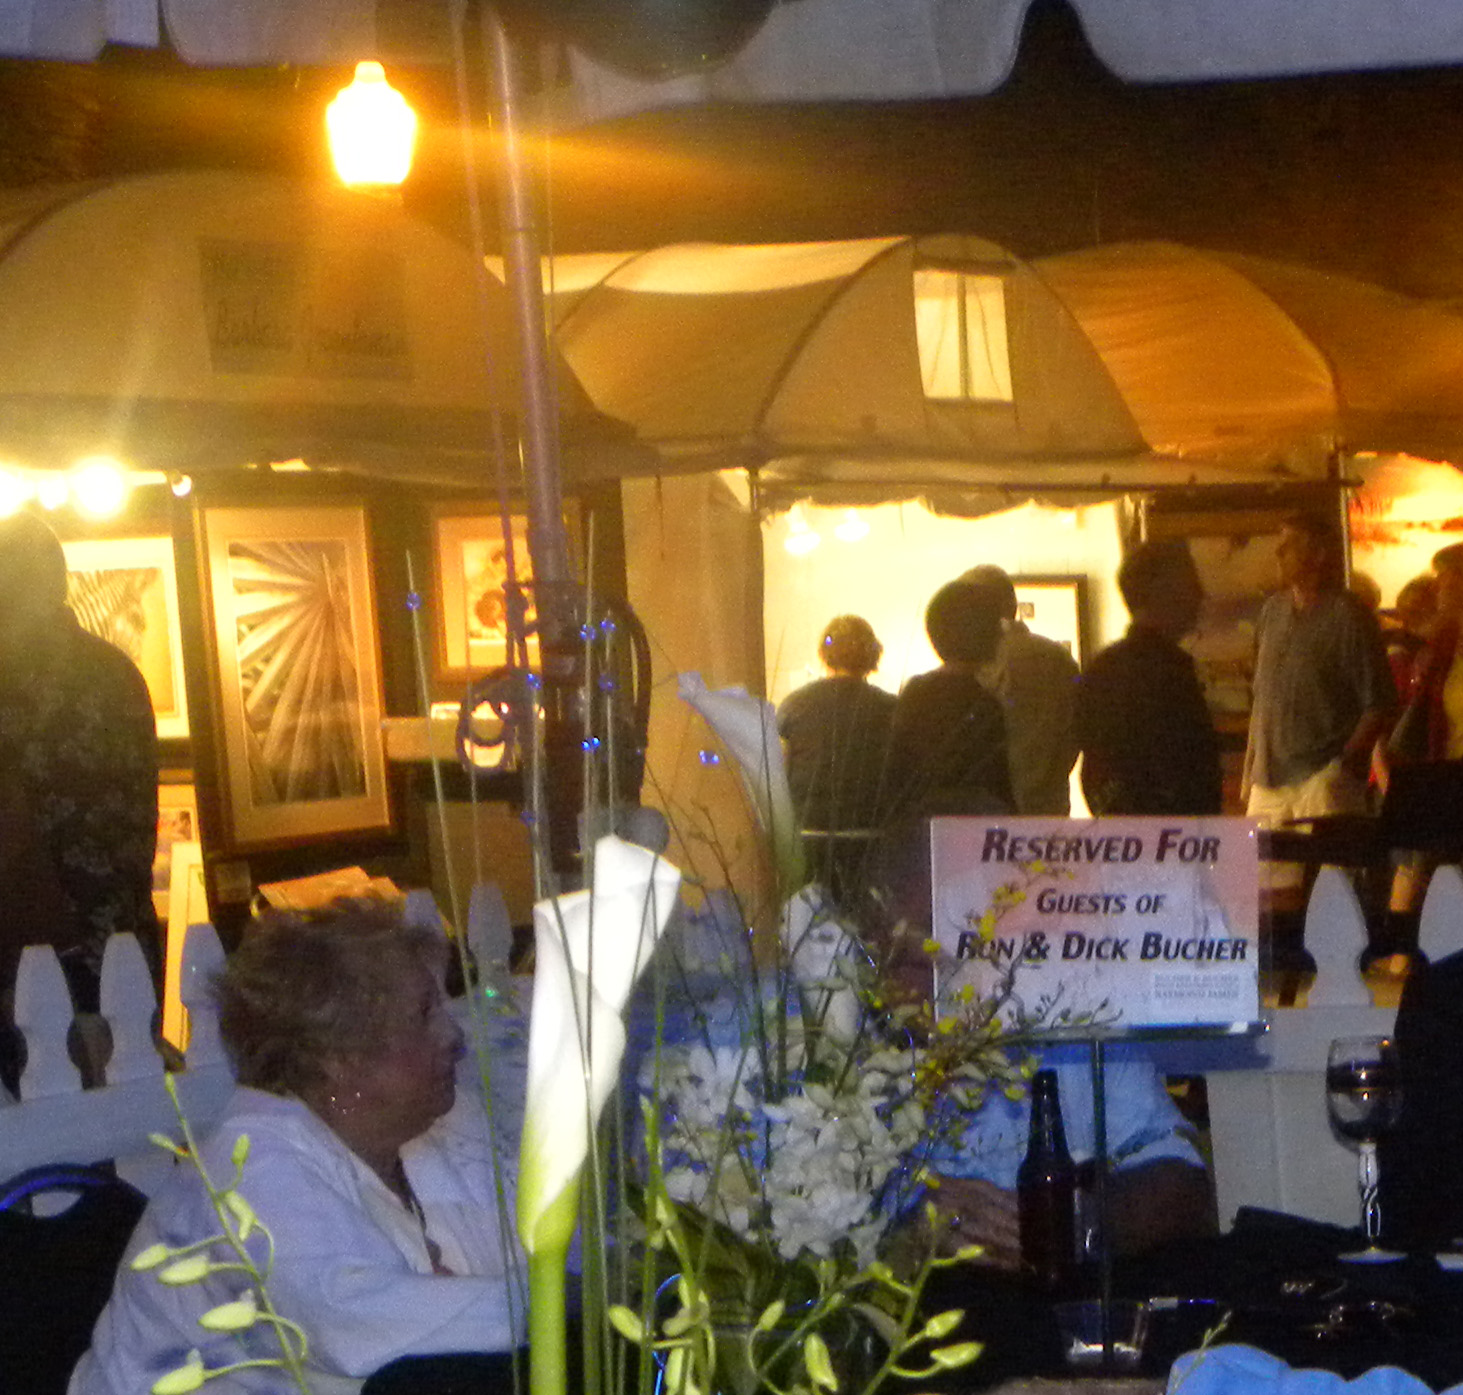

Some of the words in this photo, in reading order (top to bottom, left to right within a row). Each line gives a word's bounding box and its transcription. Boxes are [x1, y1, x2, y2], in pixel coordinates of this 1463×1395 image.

[981, 828, 1143, 863] RESERVED
[1155, 828, 1220, 862] FOR
[1037, 888, 1126, 914] GUESTS
[1136, 894, 1166, 914] OF
[1023, 930, 1050, 960] &
[1062, 930, 1130, 960] DICK
[1140, 930, 1248, 961] BUCHER
